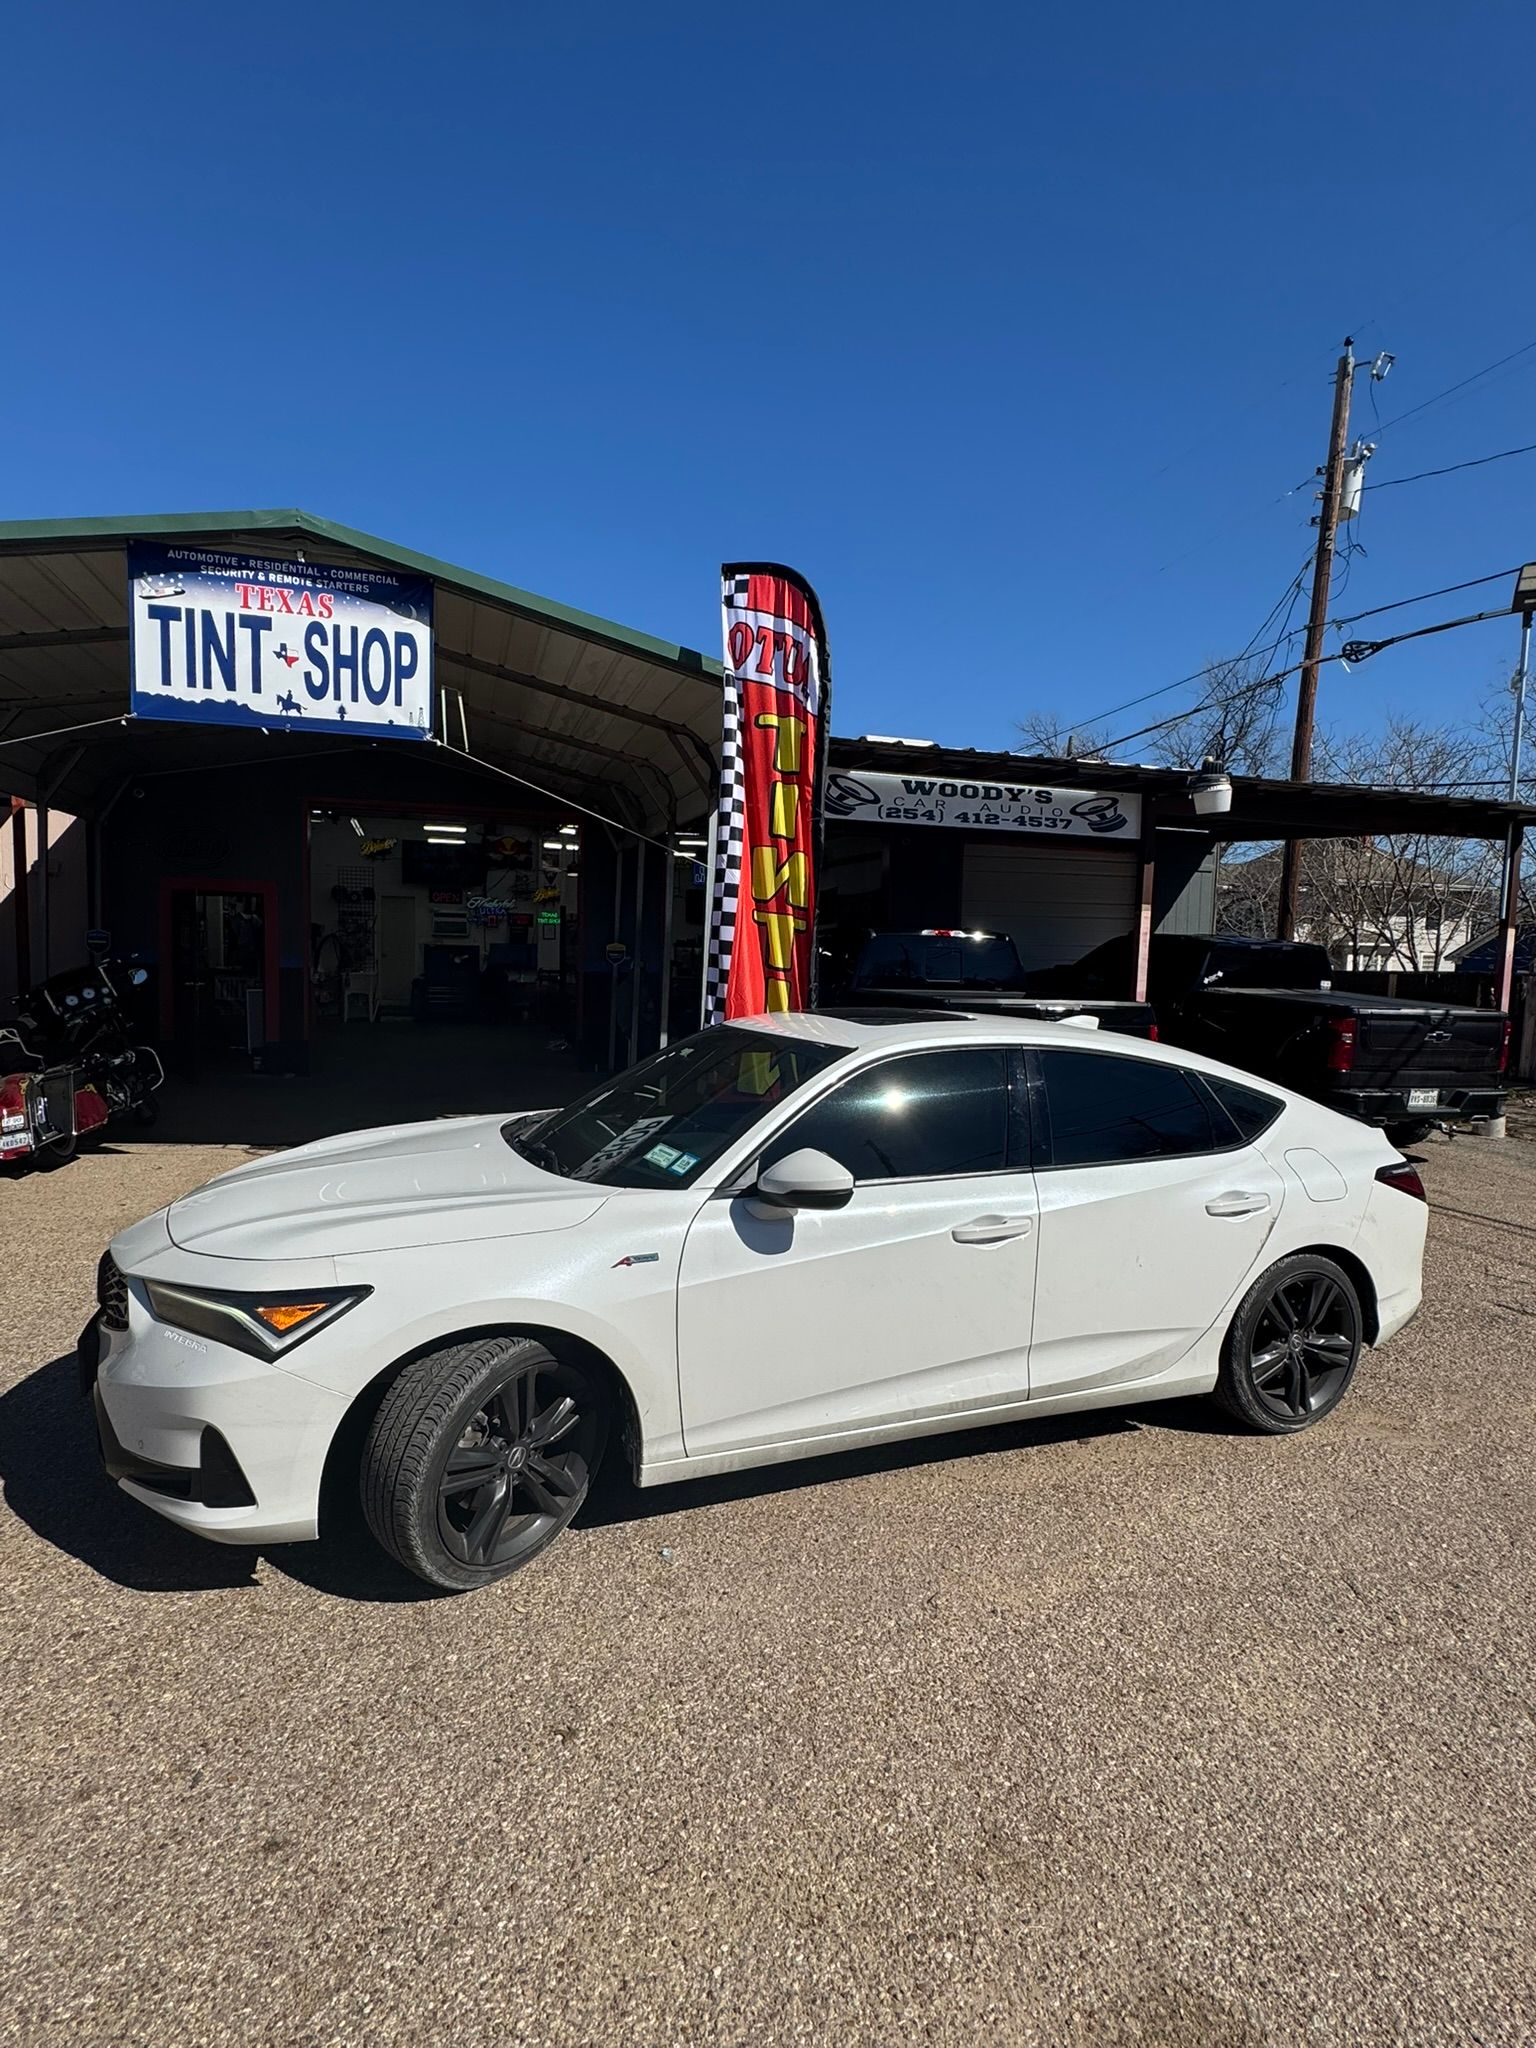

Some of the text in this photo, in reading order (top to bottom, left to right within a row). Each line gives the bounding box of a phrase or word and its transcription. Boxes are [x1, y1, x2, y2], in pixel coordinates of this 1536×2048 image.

[167, 549, 399, 586] AUTOMOTIVE RESIDENTIAL COMMERCIAL
[200, 565, 370, 593] SECURITY & REMOTE STARTERS
[235, 583, 334, 619] TEXAS
[148, 604, 418, 707] TINT SHOP
[900, 779, 1053, 804] WOODY'S
[877, 803, 1073, 830] (254) 412-4537
[893, 796, 1064, 817] CAR AUDIO
[163, 1330, 208, 1353] INTEGRA
